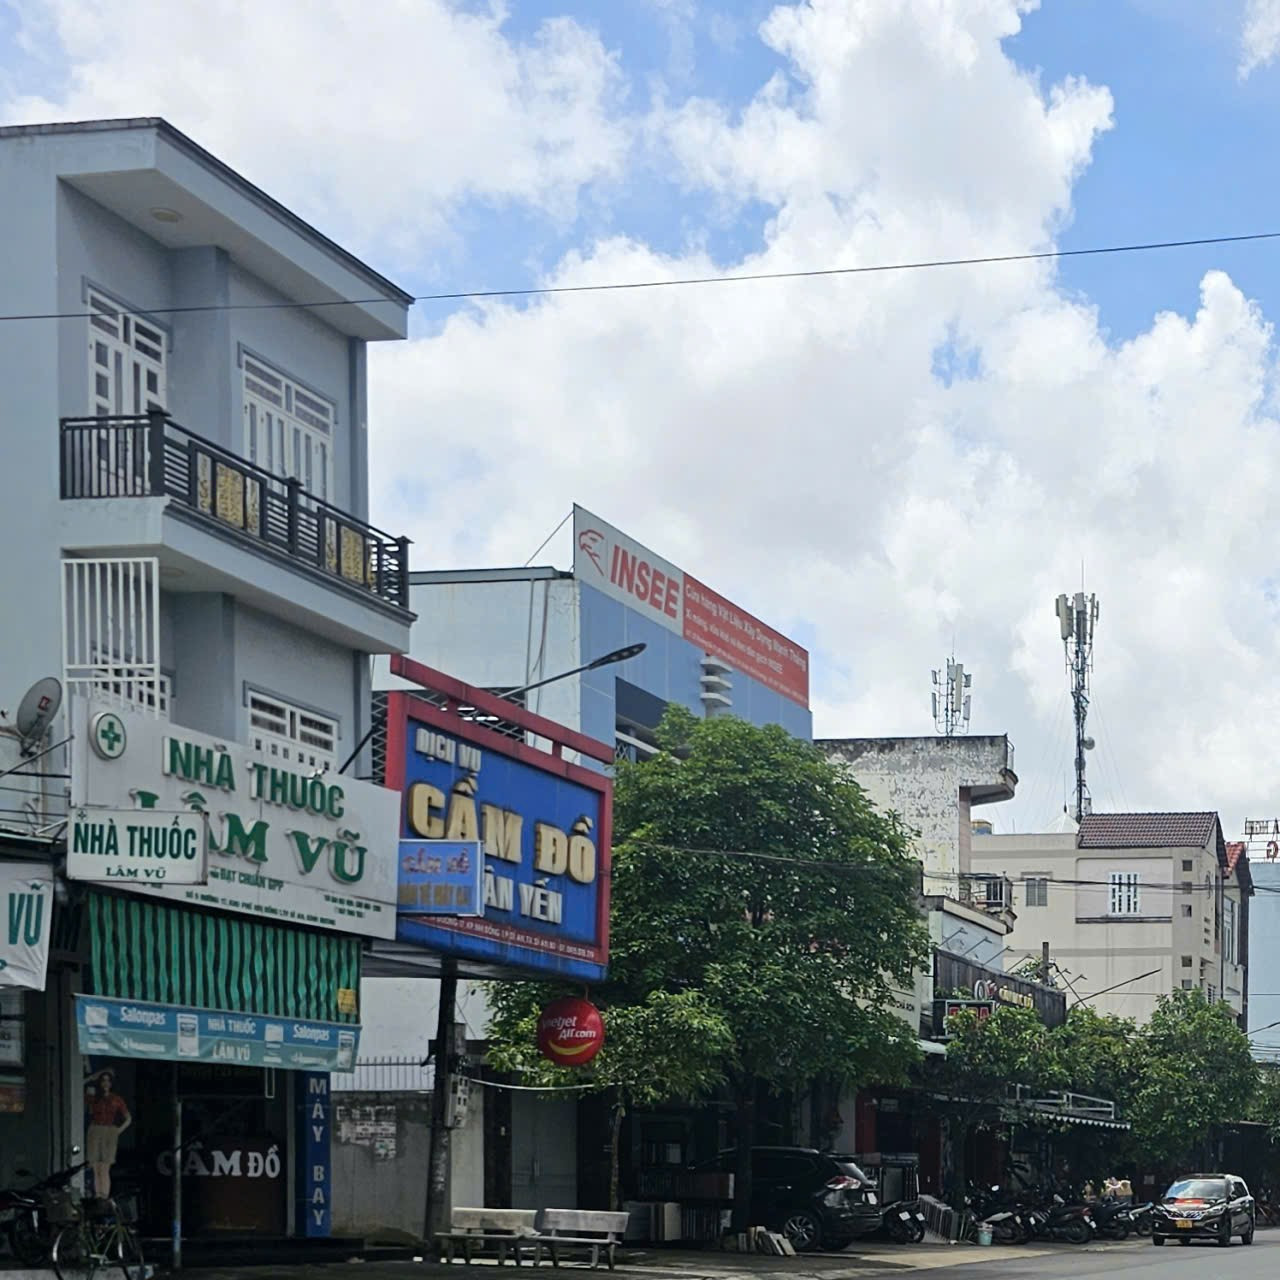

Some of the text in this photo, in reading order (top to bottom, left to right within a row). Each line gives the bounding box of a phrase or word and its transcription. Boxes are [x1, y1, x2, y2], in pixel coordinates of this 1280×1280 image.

[610, 545, 680, 619] INSEE
[416, 728, 457, 763] DỊCH
[164, 736, 345, 820] NHÀ THUỐC
[73, 818, 119, 856] NHÀ
[126, 815, 197, 860] THUỐC
[288, 827, 368, 884] VŨ
[410, 775, 597, 884] CẦM ĐỒ
[106, 865, 167, 879] LÂM VŨ
[484, 864, 514, 911] ÂN
[518, 877, 563, 924] YẾN
[8, 883, 44, 947] VŨ
[120, 1006, 167, 1027] Salonpas
[292, 1023, 330, 1043] Salonpas
[559, 1028, 597, 1040] Air.com
[247, 1144, 281, 1178] ĐỒ
[312, 1165, 325, 1226] BAY
